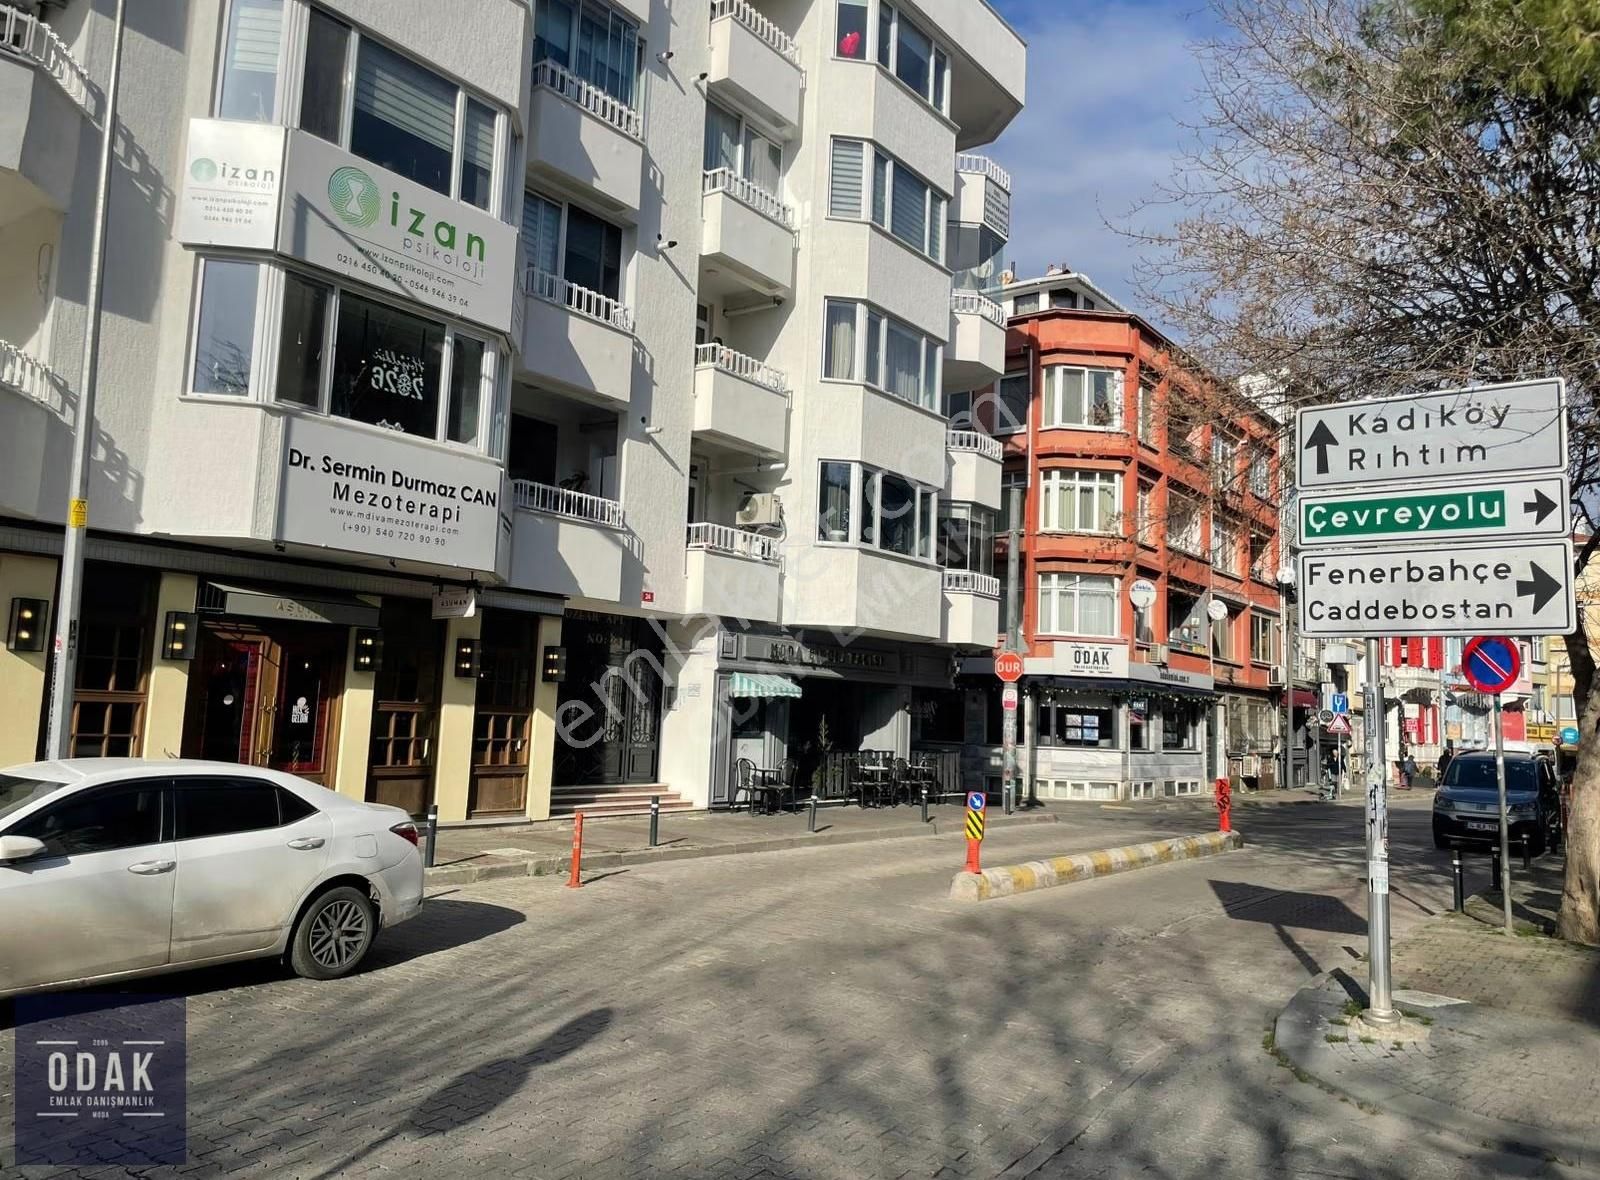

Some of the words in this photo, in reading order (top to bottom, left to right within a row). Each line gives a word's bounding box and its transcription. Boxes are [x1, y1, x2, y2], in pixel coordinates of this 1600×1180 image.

[221, 162, 274, 181] izan
[391, 191, 485, 262] izan
[357, 246, 455, 287] www.izanpsikoloji.com
[403, 237, 484, 278] psikoloji
[337, 253, 358, 268] 0216
[361, 261, 377, 275] 450
[380, 266, 390, 279] 40
[393, 272, 402, 284] 20
[409, 279, 428, 293] 0546
[432, 286, 445, 299] 946
[448, 292, 457, 303] 39
[459, 297, 469, 307] 04
[1348, 402, 1511, 436] Kadıköy
[1348, 444, 1487, 471] Rıhtım
[288, 448, 315, 471] Dr.
[321, 455, 386, 485] Sermin
[392, 470, 456, 499] Durmaz
[460, 486, 496, 508] CAN
[332, 481, 461, 523] Mezoterapi
[1308, 495, 1500, 533] Çevreyolu
[329, 506, 459, 535] www.mdivamezoterapi.com
[342, 522, 371, 536] (+90)
[375, 527, 394, 539] 540
[398, 531, 415, 542] 720
[419, 535, 431, 544] 90
[434, 537, 446, 546] 90
[1309, 559, 1512, 586] Fenerbahçe
[1309, 599, 1513, 621] Caddebostan
[770, 642, 803, 662] MODA
[1074, 650, 1109, 665] ODAK
[997, 661, 1020, 673] DUR
